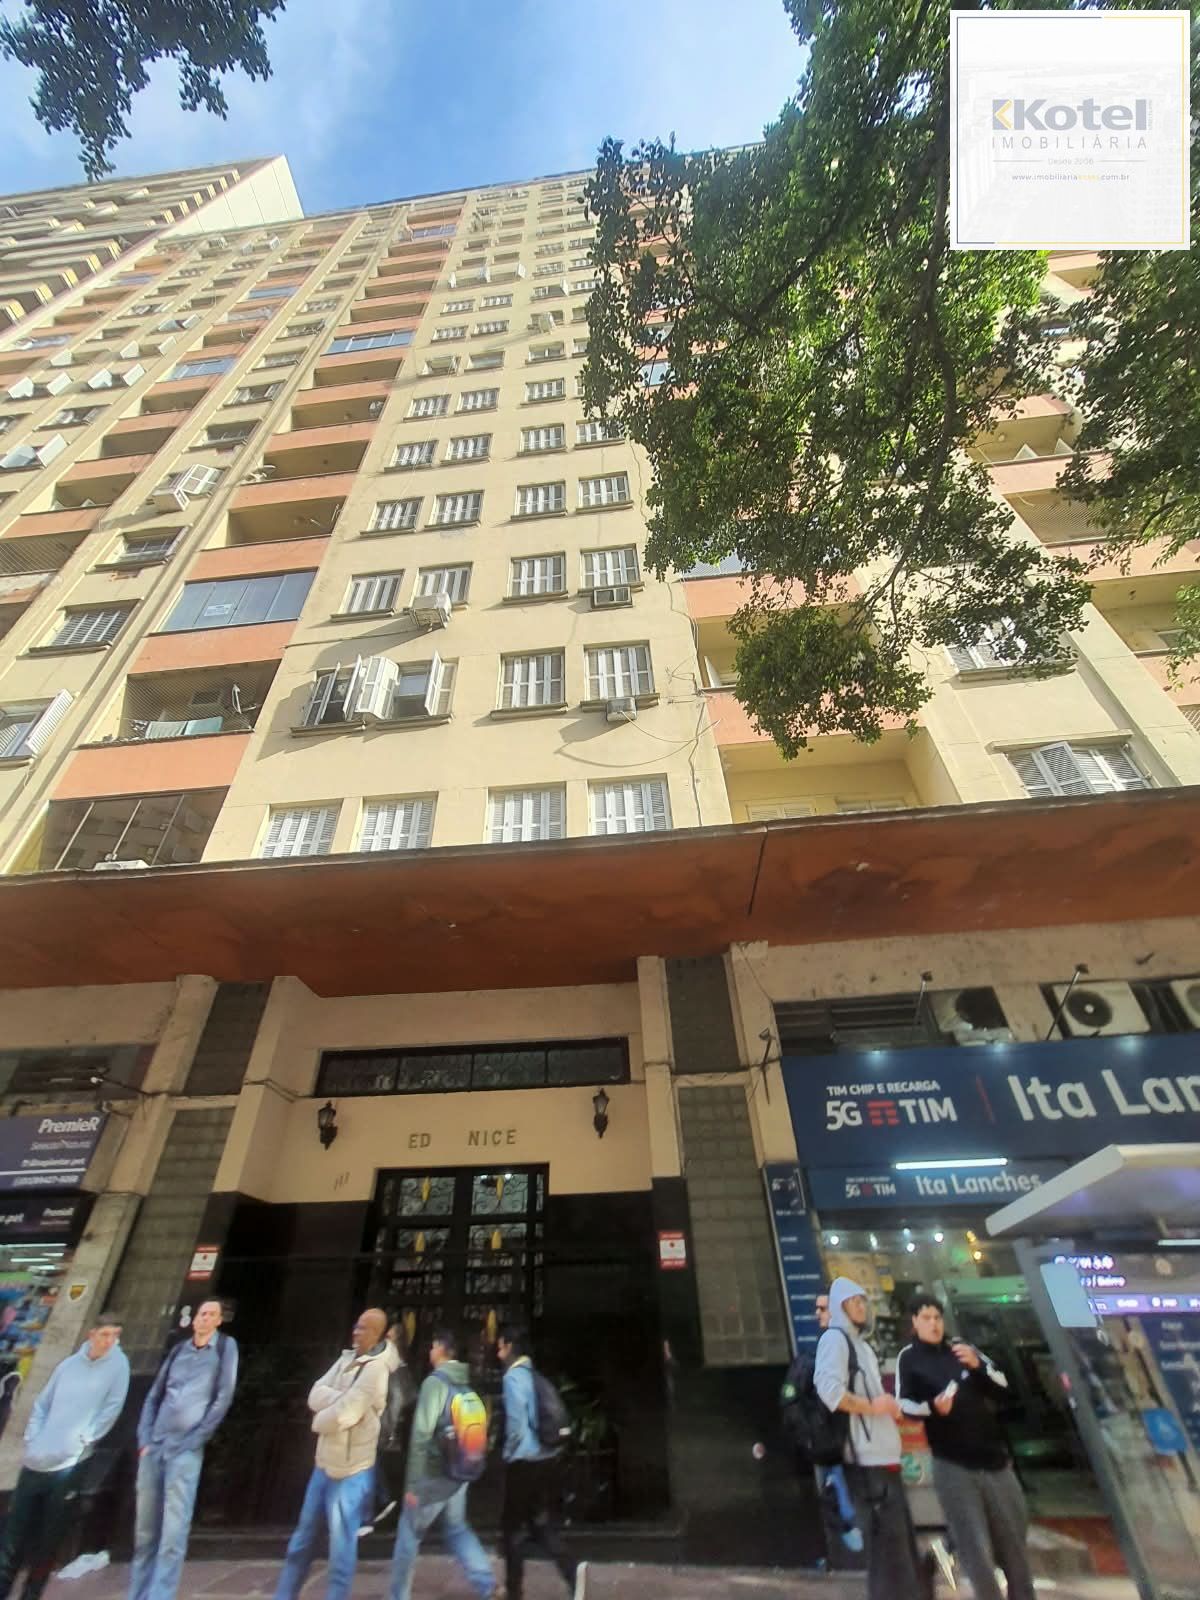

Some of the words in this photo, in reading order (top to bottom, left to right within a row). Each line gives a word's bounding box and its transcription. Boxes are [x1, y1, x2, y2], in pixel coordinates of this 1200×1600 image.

[826, 1085, 848, 1096] TIM
[849, 1083, 875, 1095] CHIP
[876, 1082, 886, 1094] E
[886, 1080, 941, 1093] RECARGA
[1007, 1075, 1097, 1121] Ita
[826, 1100, 863, 1130] 5G
[899, 1097, 958, 1124] TIM
[408, 1132, 431, 1148] ED
[467, 1129, 517, 1146] NICE
[845, 1183, 861, 1198] 5G
[873, 1183, 897, 1196] TIM
[915, 1175, 948, 1196] Ita
[950, 1173, 1043, 1195] Lanches
